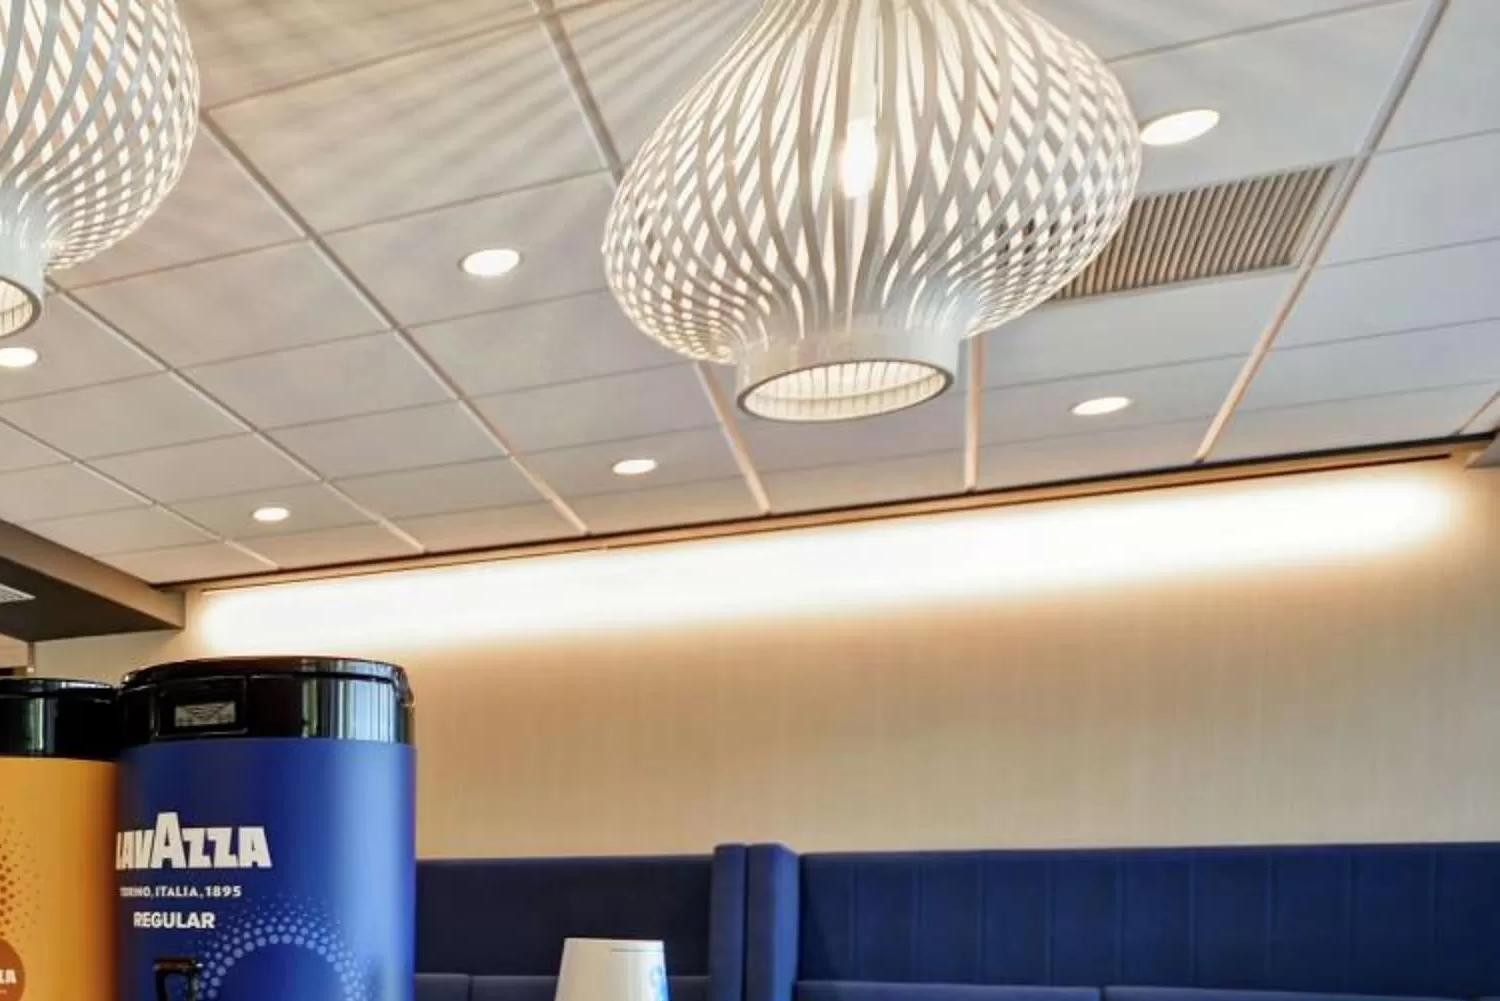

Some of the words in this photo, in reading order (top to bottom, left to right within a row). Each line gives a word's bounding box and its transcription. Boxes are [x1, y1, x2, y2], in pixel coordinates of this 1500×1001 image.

[115, 811, 272, 870] LAVAZZA
[205, 885, 242, 897] 1895
[133, 911, 216, 929] REGULAR
